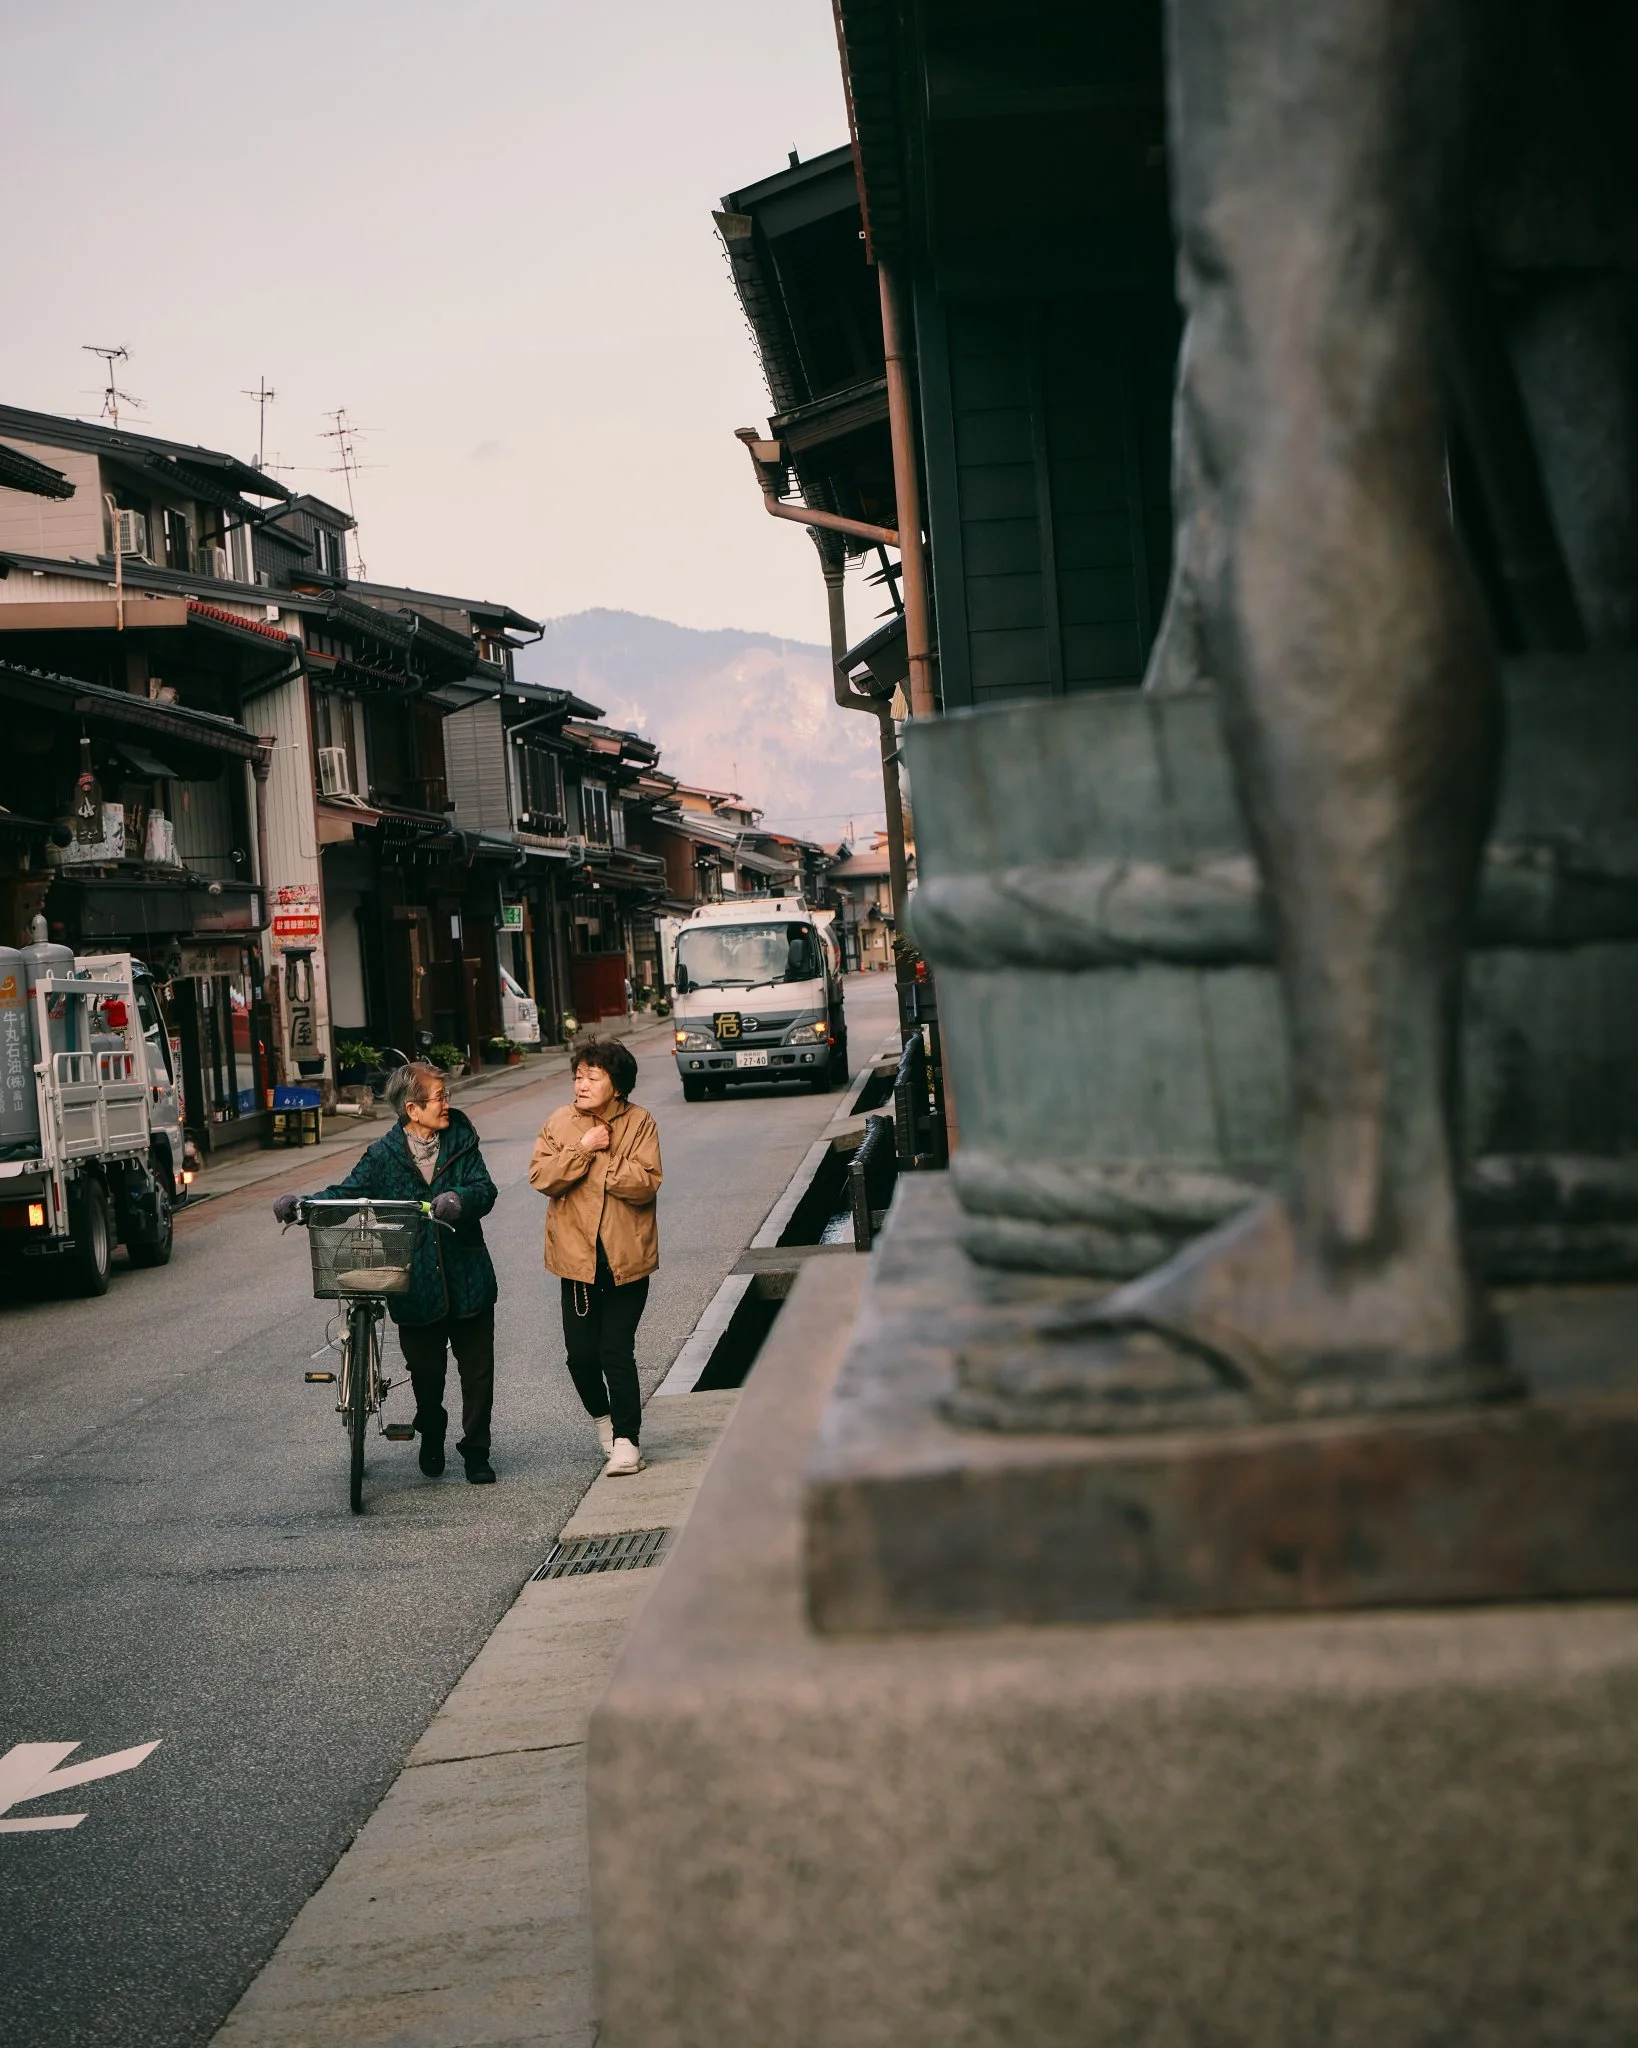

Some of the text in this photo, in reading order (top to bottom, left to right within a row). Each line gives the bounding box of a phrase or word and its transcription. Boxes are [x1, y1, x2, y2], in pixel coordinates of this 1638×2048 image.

[716, 1014, 739, 1038] 危
[3, 1010, 26, 1089] 牛丸石油(株)
[743, 1057, 766, 1066] 27-40
[22, 1240, 76, 1256] ELF
